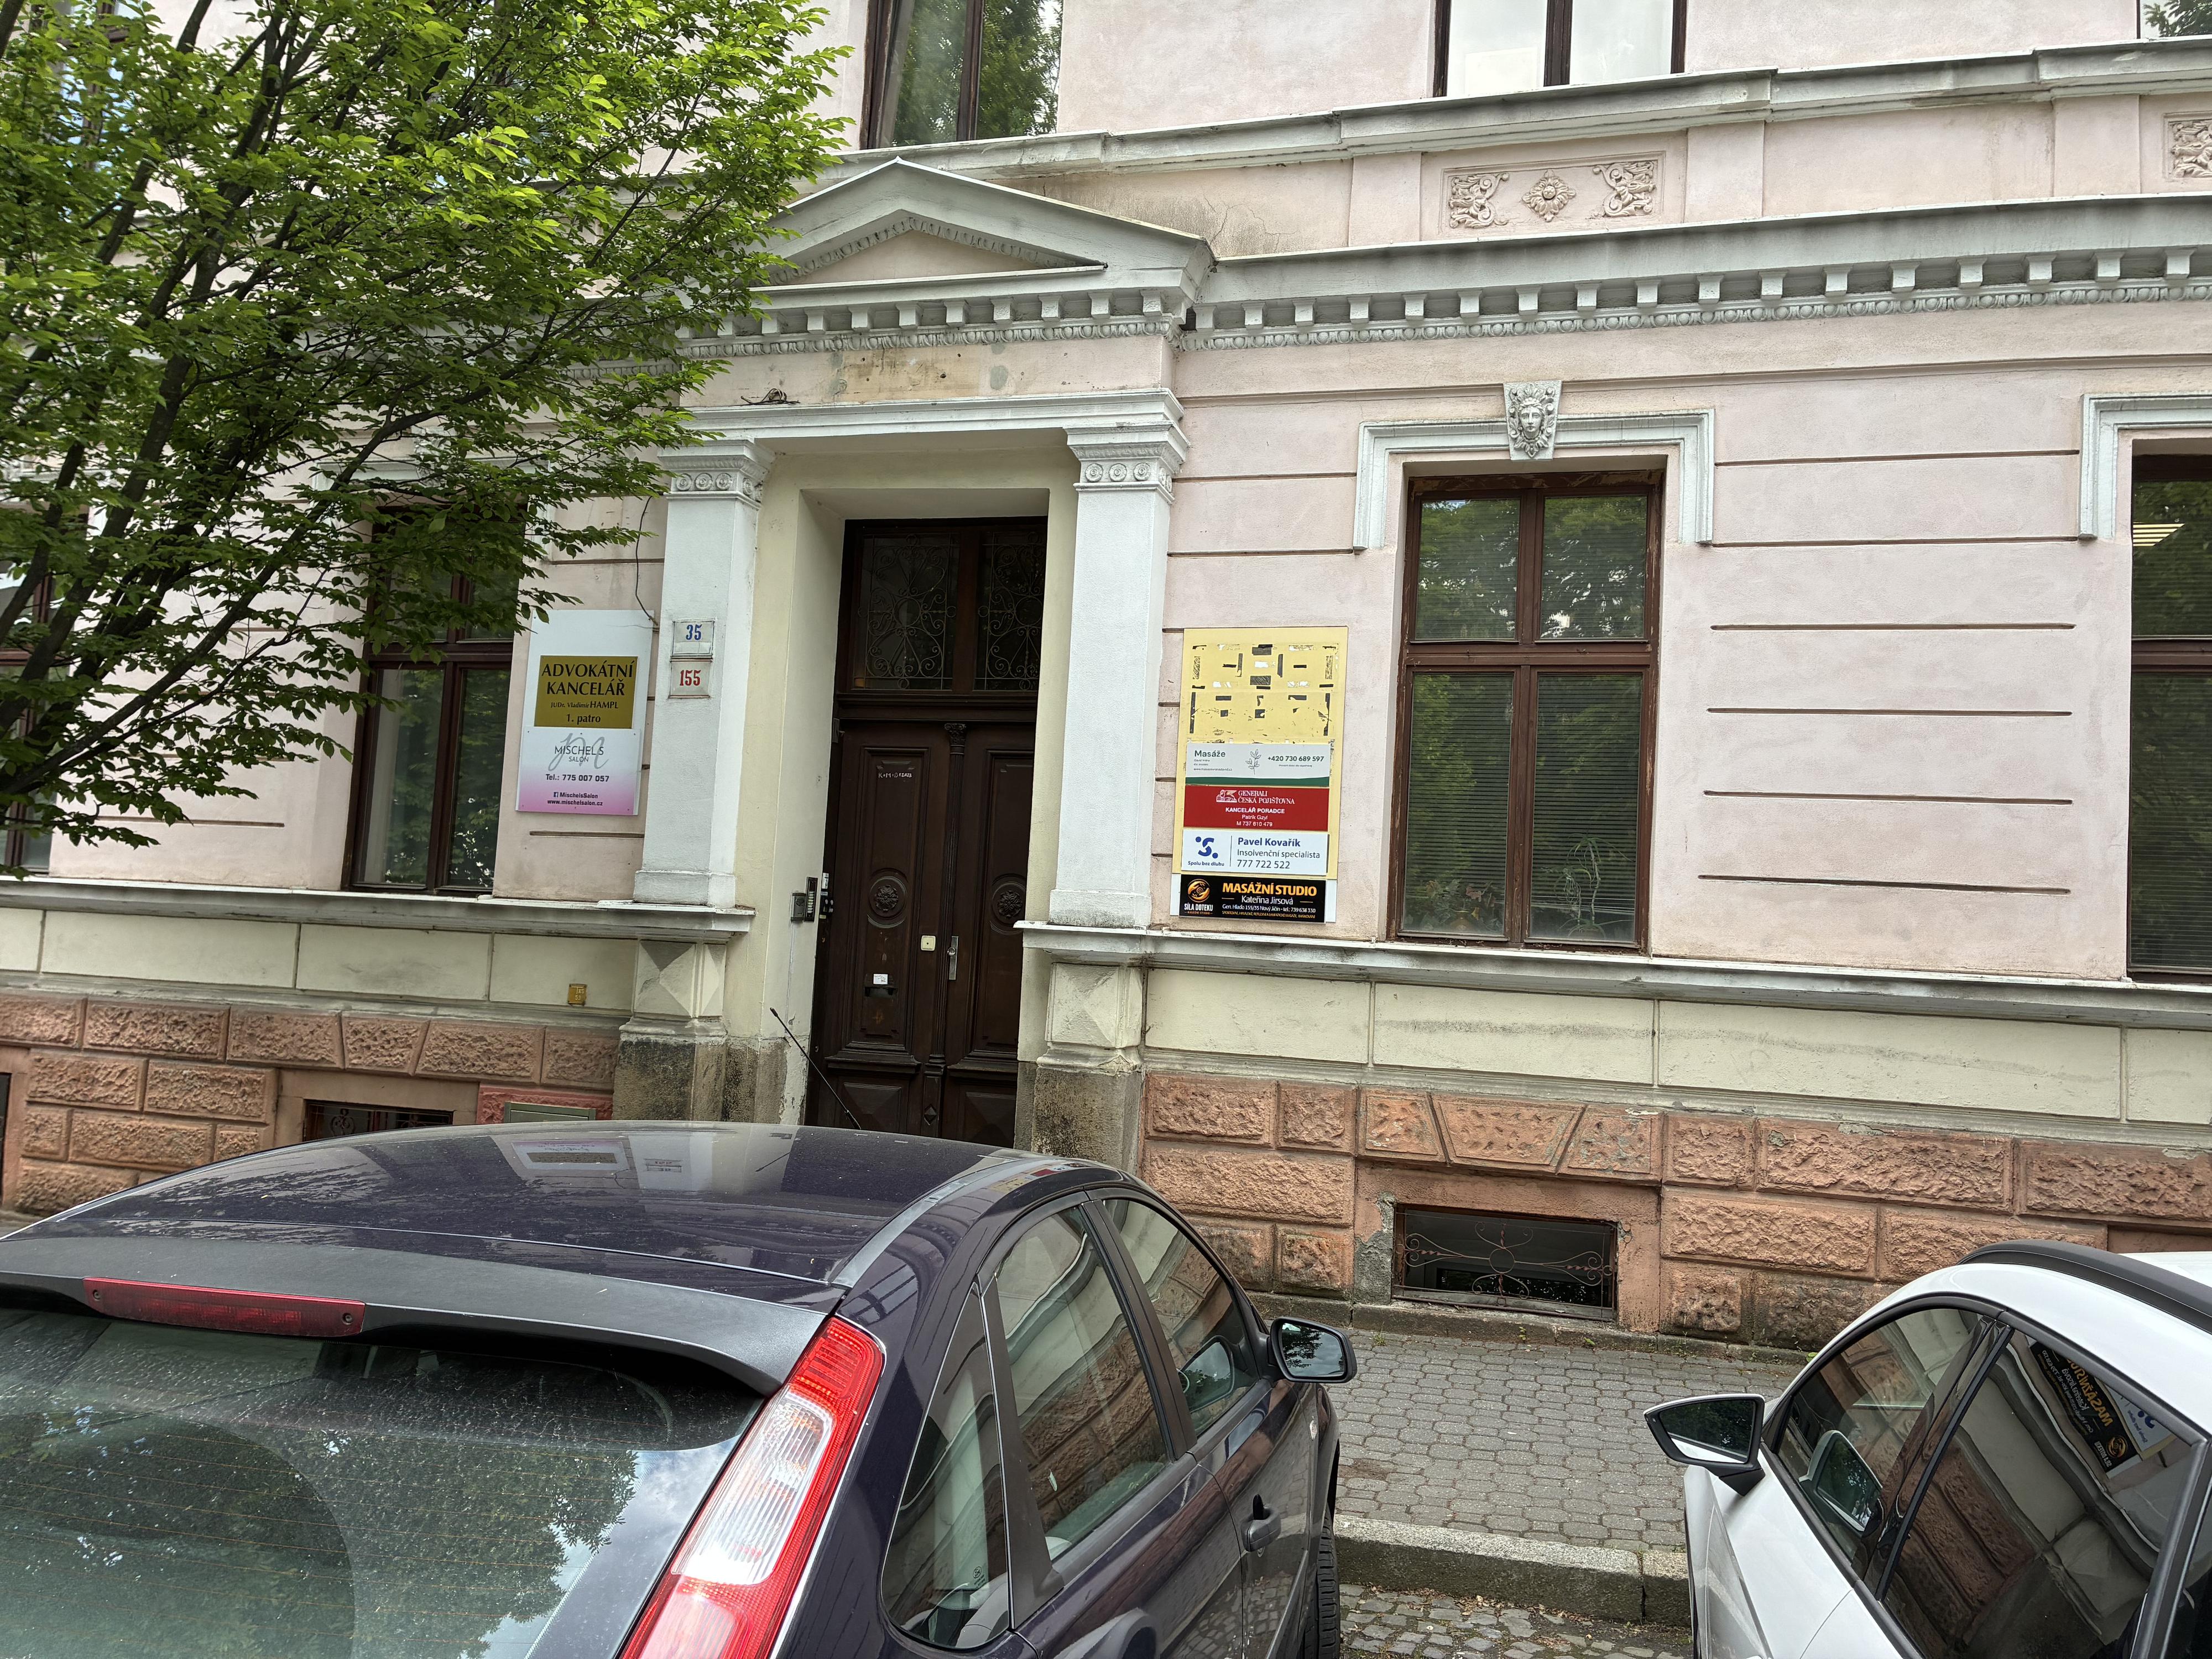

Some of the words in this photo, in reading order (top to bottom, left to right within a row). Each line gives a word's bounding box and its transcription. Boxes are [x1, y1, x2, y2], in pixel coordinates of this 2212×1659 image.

[686, 624, 702, 640] 35
[541, 660, 635, 677] ADVOKÁTNÍ
[680, 670, 701, 686] 155
[547, 679, 625, 696] KANCELÁŘ
[577, 714, 601, 725] patro
[1238, 837, 1262, 846] Pavel
[1265, 838, 1301, 847] Kovařík
[1237, 849, 1279, 857] Insolvenční
[1281, 851, 1320, 859] specialista
[1237, 859, 1253, 868] 777
[1255, 860, 1271, 868] 722
[1222, 882, 1274, 894] MASÁŽNÍ
[1275, 885, 1317, 896] STUDIO
[1241, 895, 1269, 904] Kateřina
[1270, 896, 1293, 905] Jirsová
